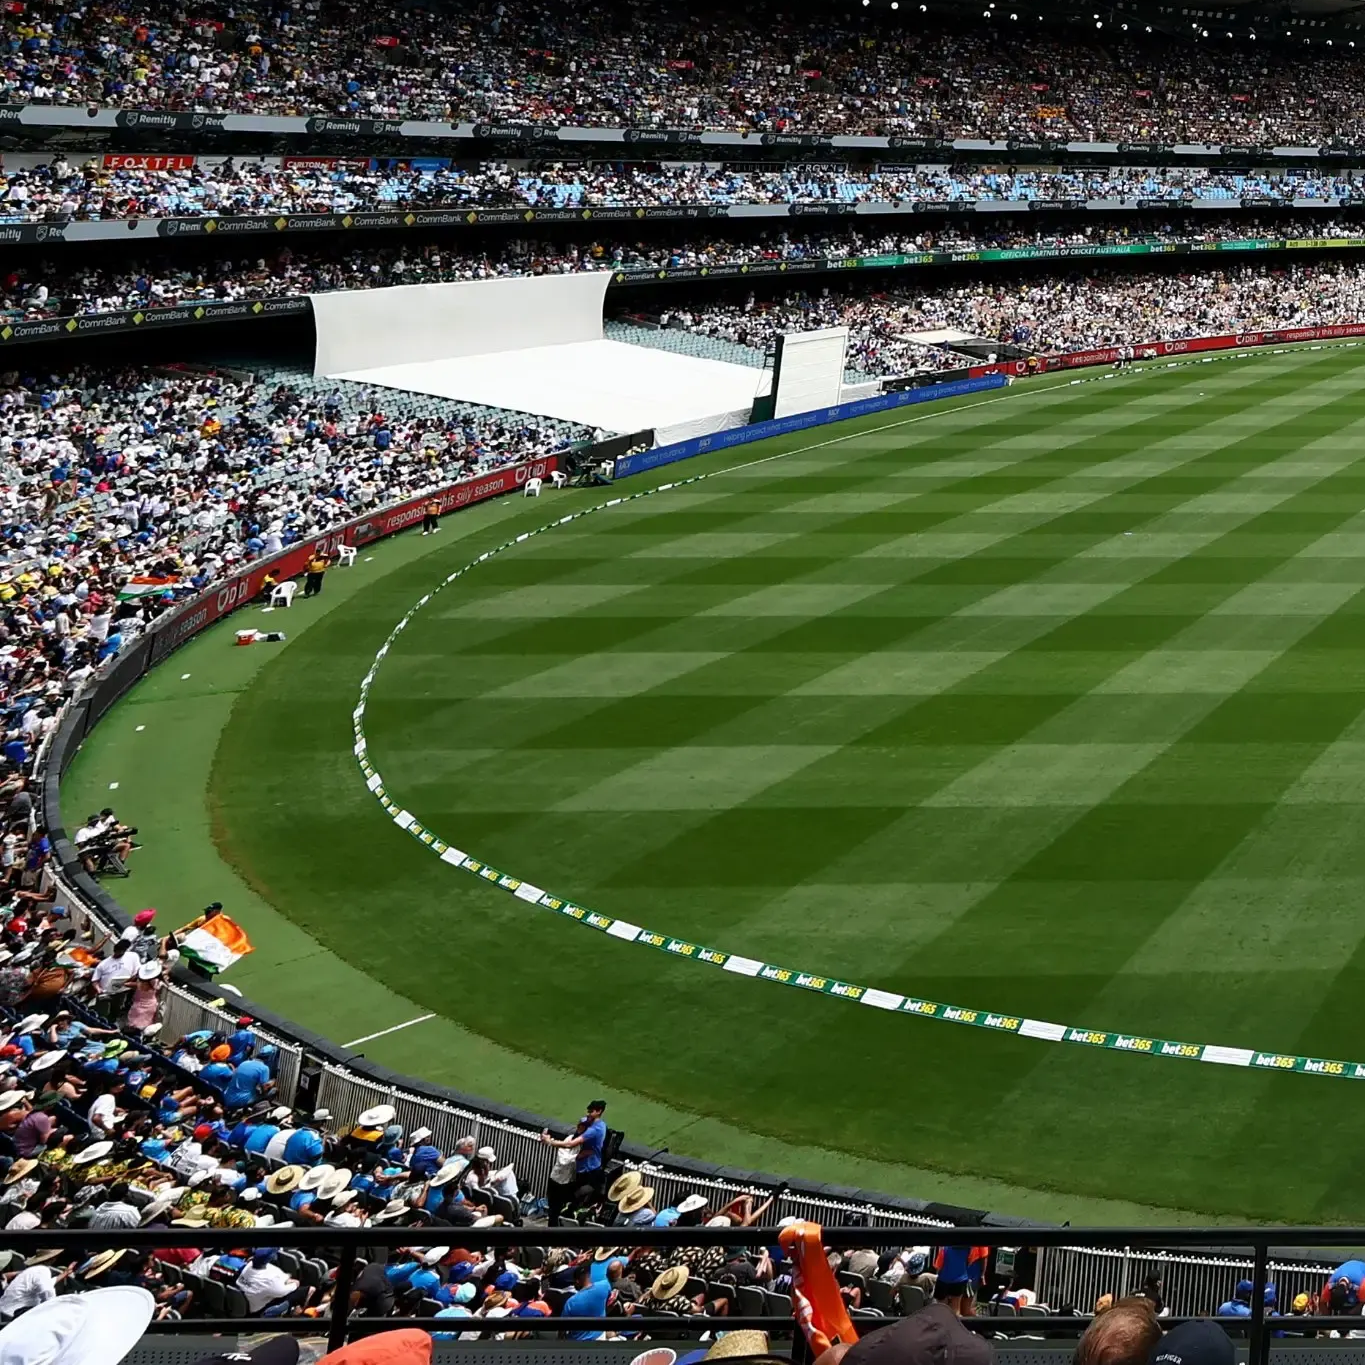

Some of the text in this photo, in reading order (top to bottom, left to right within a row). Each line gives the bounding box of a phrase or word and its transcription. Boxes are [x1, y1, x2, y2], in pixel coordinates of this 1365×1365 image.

[139, 114, 177, 127] Remitly
[326, 122, 360, 133] Remitly
[491, 127, 521, 137] Remitly
[641, 132, 668, 142] Remitly
[776, 135, 802, 145] Remitly
[110, 157, 187, 170] FOXTEL
[477, 213, 520, 222] CommBank
[535, 211, 577, 220] CommBank
[645, 209, 684, 217] CommBank
[288, 218, 336, 229] CommBank
[354, 216, 399, 225] CommBank
[416, 214, 461, 224] CommBank
[217, 220, 268, 231] CommBank
[1000, 245, 1131, 259] OFFICIAL PARTNER OF CRICKET AUSTRALIA
[1150, 244, 1176, 252] bet365
[1191, 242, 1217, 251] bet365
[903, 254, 933, 264] bet365
[952, 252, 980, 262] bet365
[827, 259, 857, 269] bet365
[625, 272, 656, 282] CommBank
[709, 267, 739, 276] CommBank
[205, 306, 248, 316] CommBank
[264, 301, 306, 311] CommBank
[145, 312, 189, 322] CommBank
[78, 318, 127, 330] CommBank
[14, 324, 60, 336] CommBank
[455, 486, 473, 504] silly
[474, 478, 504, 495] season
[698, 948, 726, 964] bet365
[761, 967, 791, 982] bet365
[831, 982, 862, 998] bet365
[904, 998, 937, 1015] bet365
[943, 1006, 977, 1022] bet365
[984, 1014, 1019, 1030] bet365
[1069, 1029, 1106, 1044] bet365
[1115, 1035, 1153, 1051] bet365
[1161, 1042, 1200, 1058] bet365
[1255, 1053, 1296, 1068] bet365
[1304, 1059, 1344, 1074] bet365
